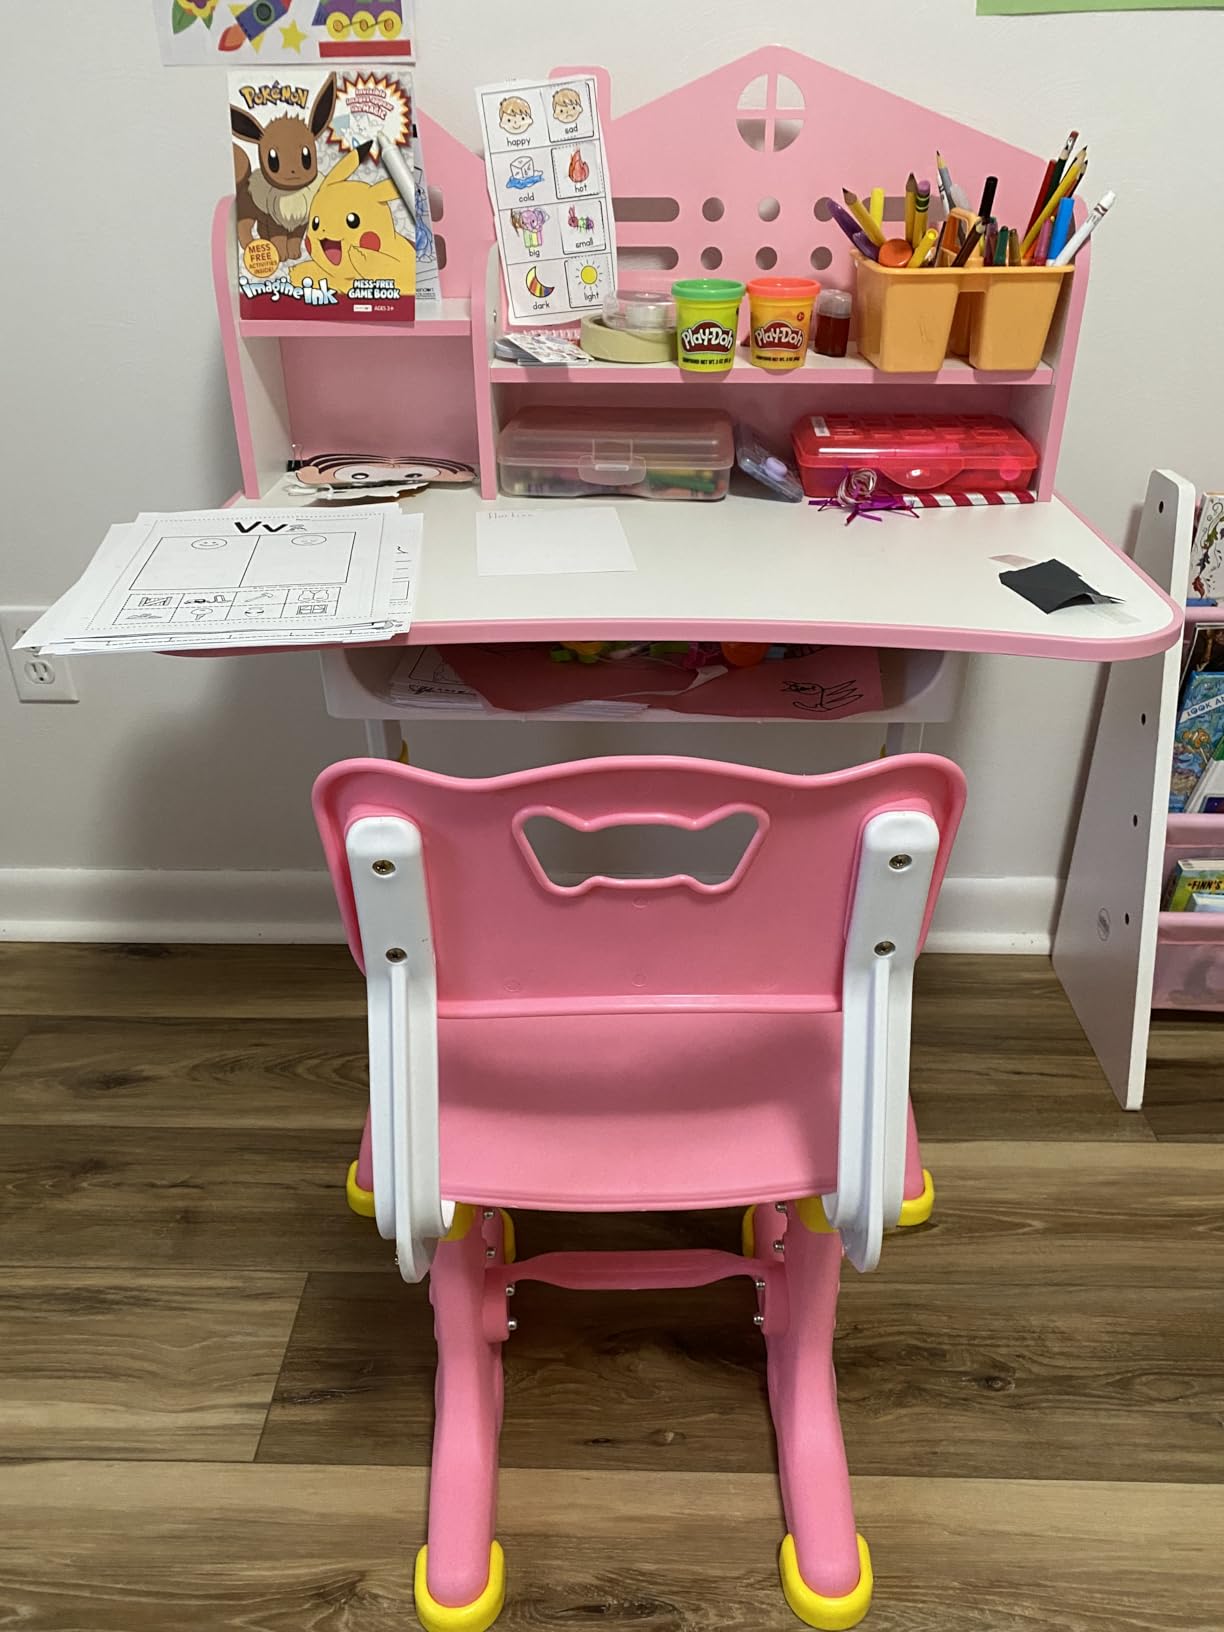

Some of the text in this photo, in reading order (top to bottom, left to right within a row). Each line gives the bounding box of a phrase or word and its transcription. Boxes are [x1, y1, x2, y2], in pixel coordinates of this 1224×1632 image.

[362, 103, 387, 120] MAGIC
[565, 123, 578, 134] sad
[506, 137, 531, 147] happy
[574, 184, 587, 193] hot
[518, 192, 535, 203] cold
[248, 243, 271, 254] MESS
[575, 237, 594, 249] small
[250, 252, 272, 263] FREE
[528, 248, 541, 258] big
[353, 279, 395, 289] MESS-FREE
[347, 287, 374, 300] GAME
[373, 287, 401, 300] BOOK
[583, 292, 599, 302] light
[532, 301, 551, 310] dark
[682, 327, 733, 350] Play-Doh
[755, 327, 803, 347] Play-Doh
[1187, 702, 1212, 717] LOOK
[1192, 880, 1221, 890] FINN'S
